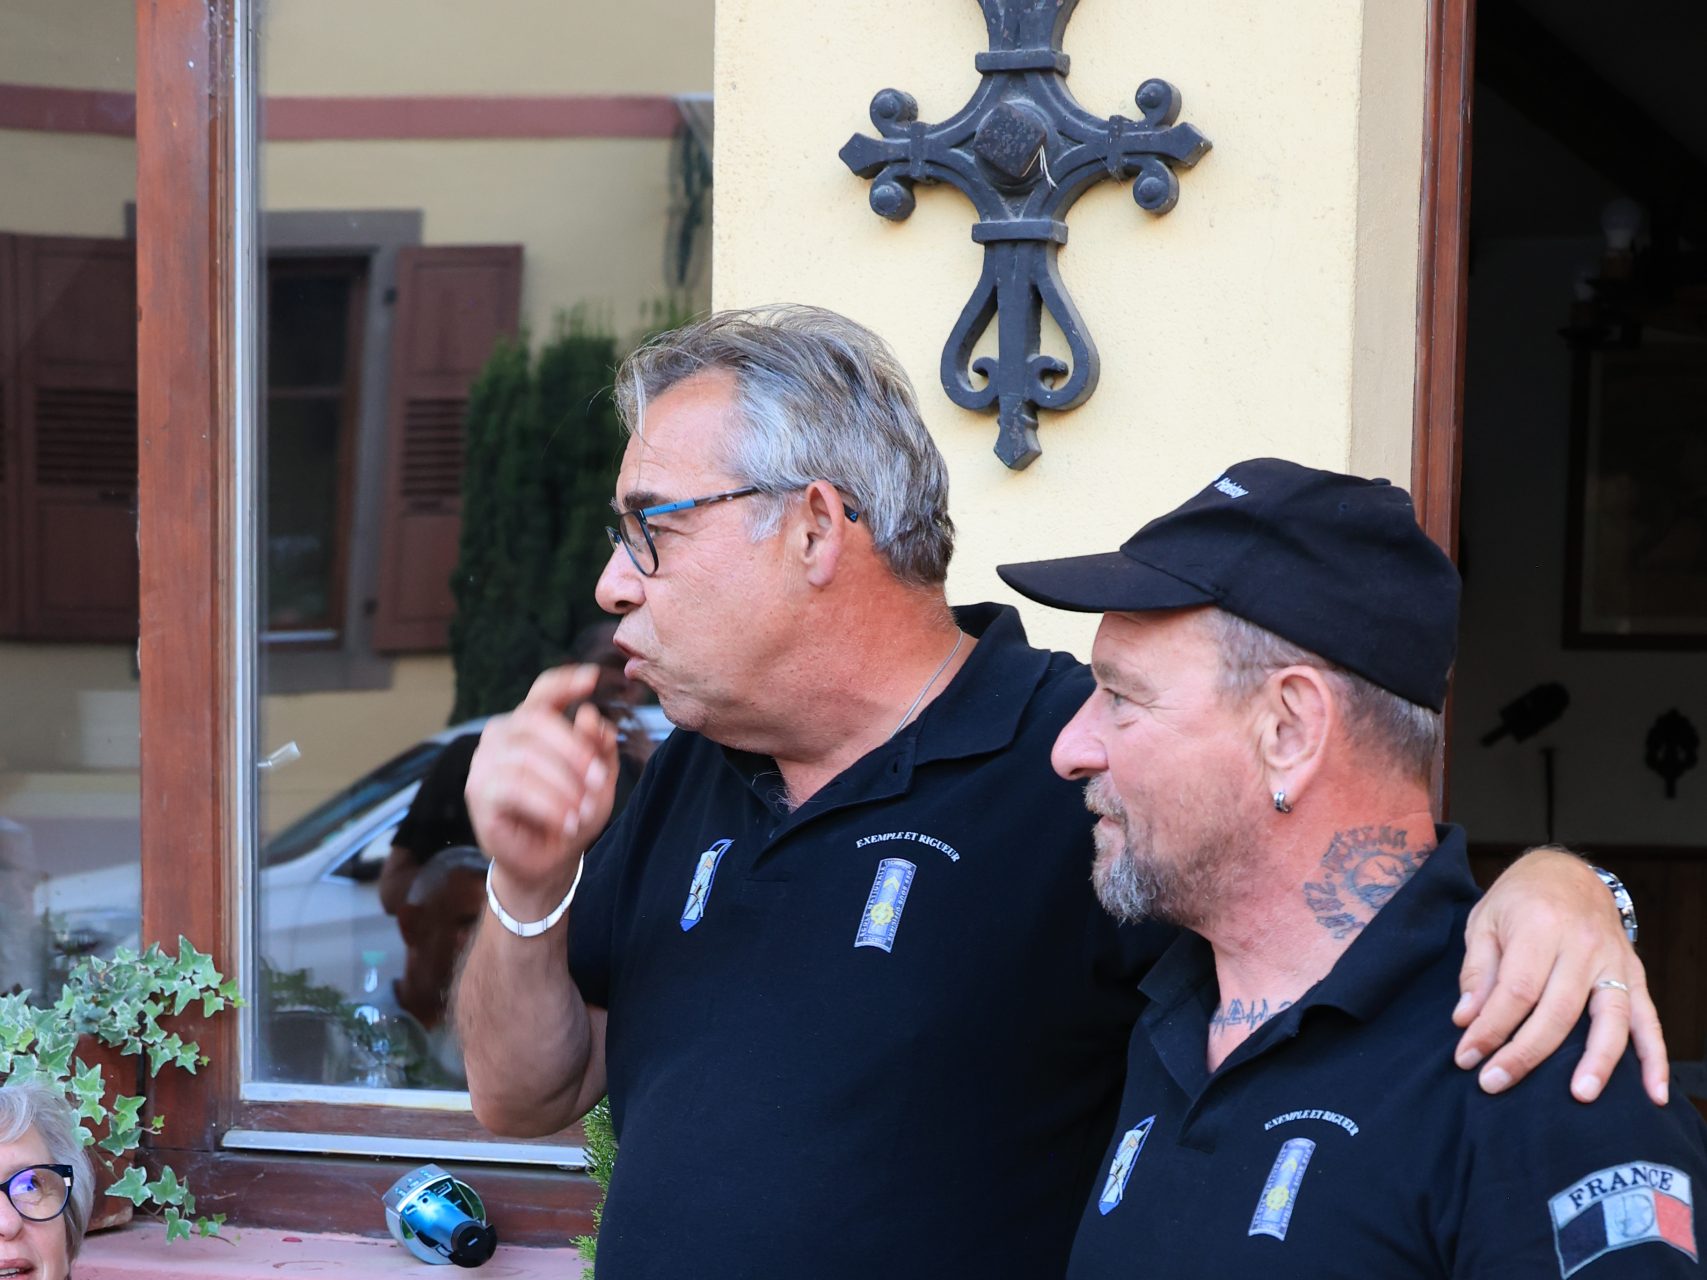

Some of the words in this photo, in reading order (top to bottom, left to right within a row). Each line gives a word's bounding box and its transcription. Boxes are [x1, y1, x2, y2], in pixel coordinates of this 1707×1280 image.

[856, 832, 904, 848] EXEMPLE
[904, 832, 919, 841] ET
[918, 833, 961, 862] RIGUEUR
[1569, 1166, 1673, 1210] FRANCE
